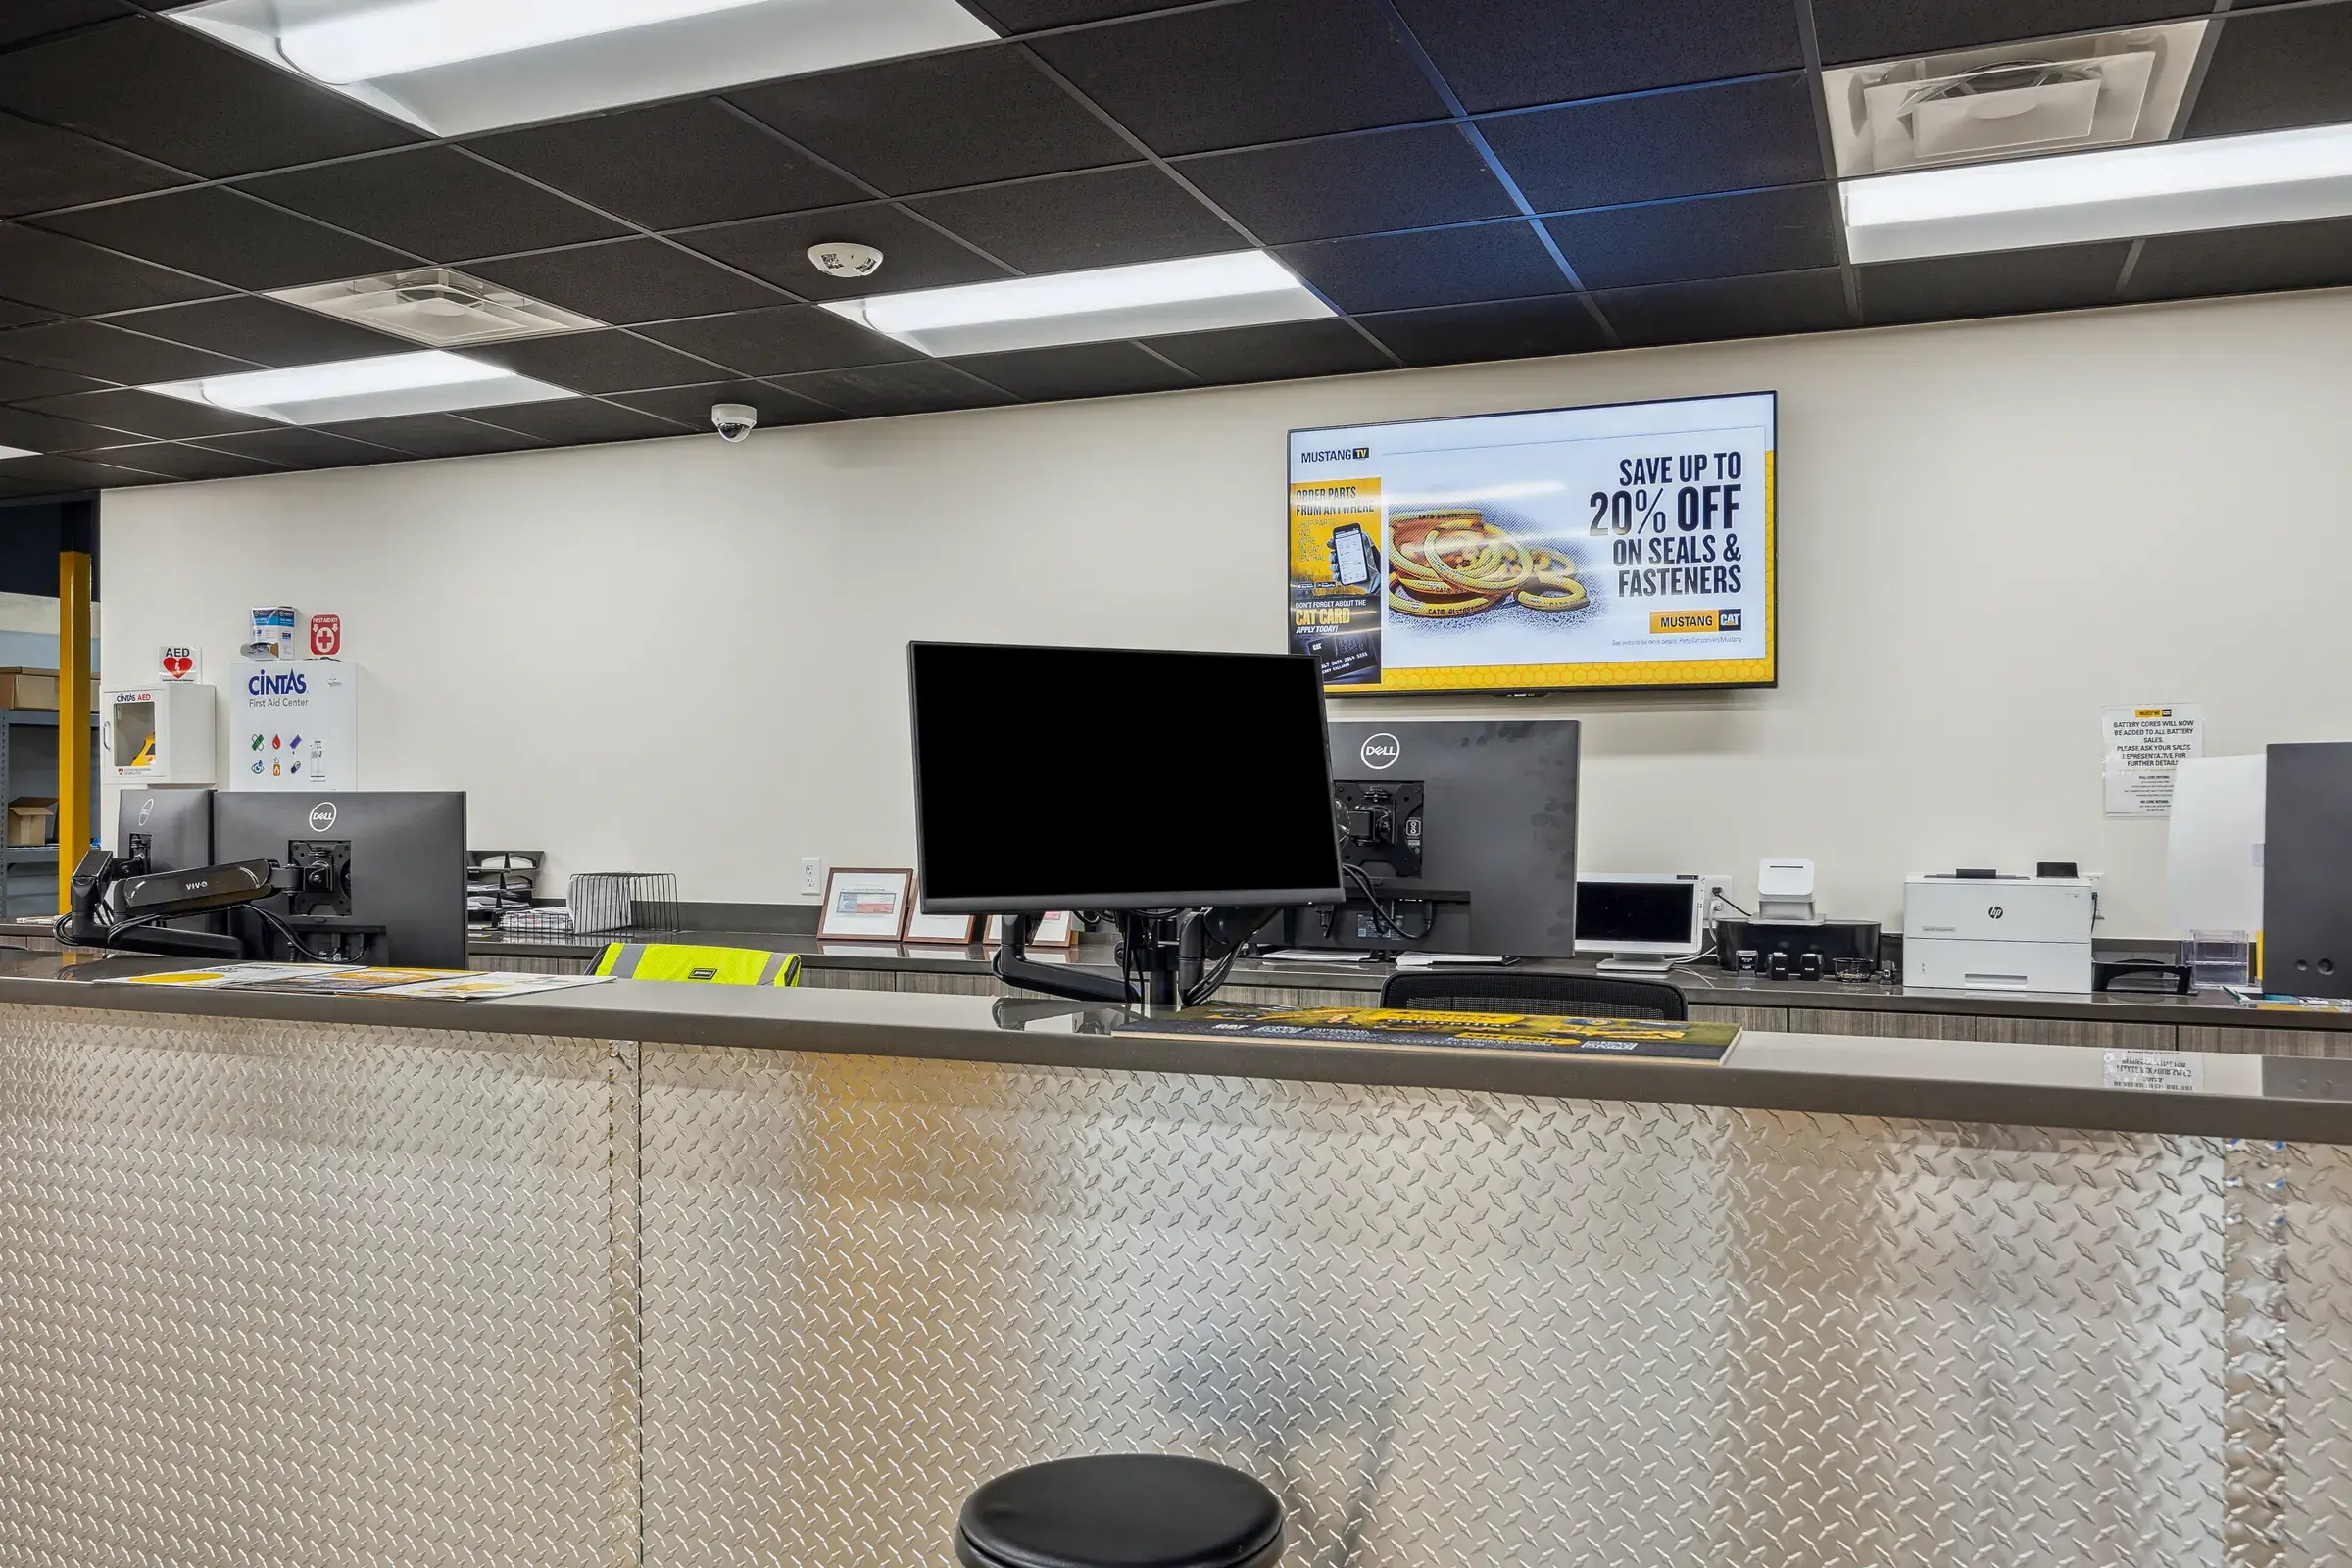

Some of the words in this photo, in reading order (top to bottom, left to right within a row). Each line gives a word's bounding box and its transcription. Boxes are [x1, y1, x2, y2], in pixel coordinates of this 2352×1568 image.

[1301, 449, 1351, 463] MUSTANG
[1355, 448, 1367, 458] TV
[1619, 456, 1673, 486] SAVE
[1679, 454, 1708, 482] UP
[1713, 451, 1741, 480] TO
[1296, 489, 1326, 502] ORDER
[1328, 486, 1356, 500] PARTS
[1296, 504, 1322, 516] FROM
[1590, 487, 1666, 536] 20%
[1677, 484, 1741, 532] OFF
[1315, 518, 1336, 527] PARTS
[1613, 538, 1642, 566] ON
[1648, 534, 1716, 565] SEALS
[1723, 533, 1742, 562] &
[1618, 564, 1742, 598] FASTENERS
[1295, 608, 1318, 626] CAT
[1319, 607, 1350, 625] CARD
[1660, 615, 1713, 628] MUSTANG
[1720, 613, 1741, 626] CAT
[165, 648, 190, 657] AED
[249, 698, 266, 708] First
[268, 697, 280, 707] Aid
[282, 697, 309, 707] Center
[1365, 745, 1396, 757] DELL
[312, 812, 333, 821] DELL
[1988, 906, 2003, 920] hp
